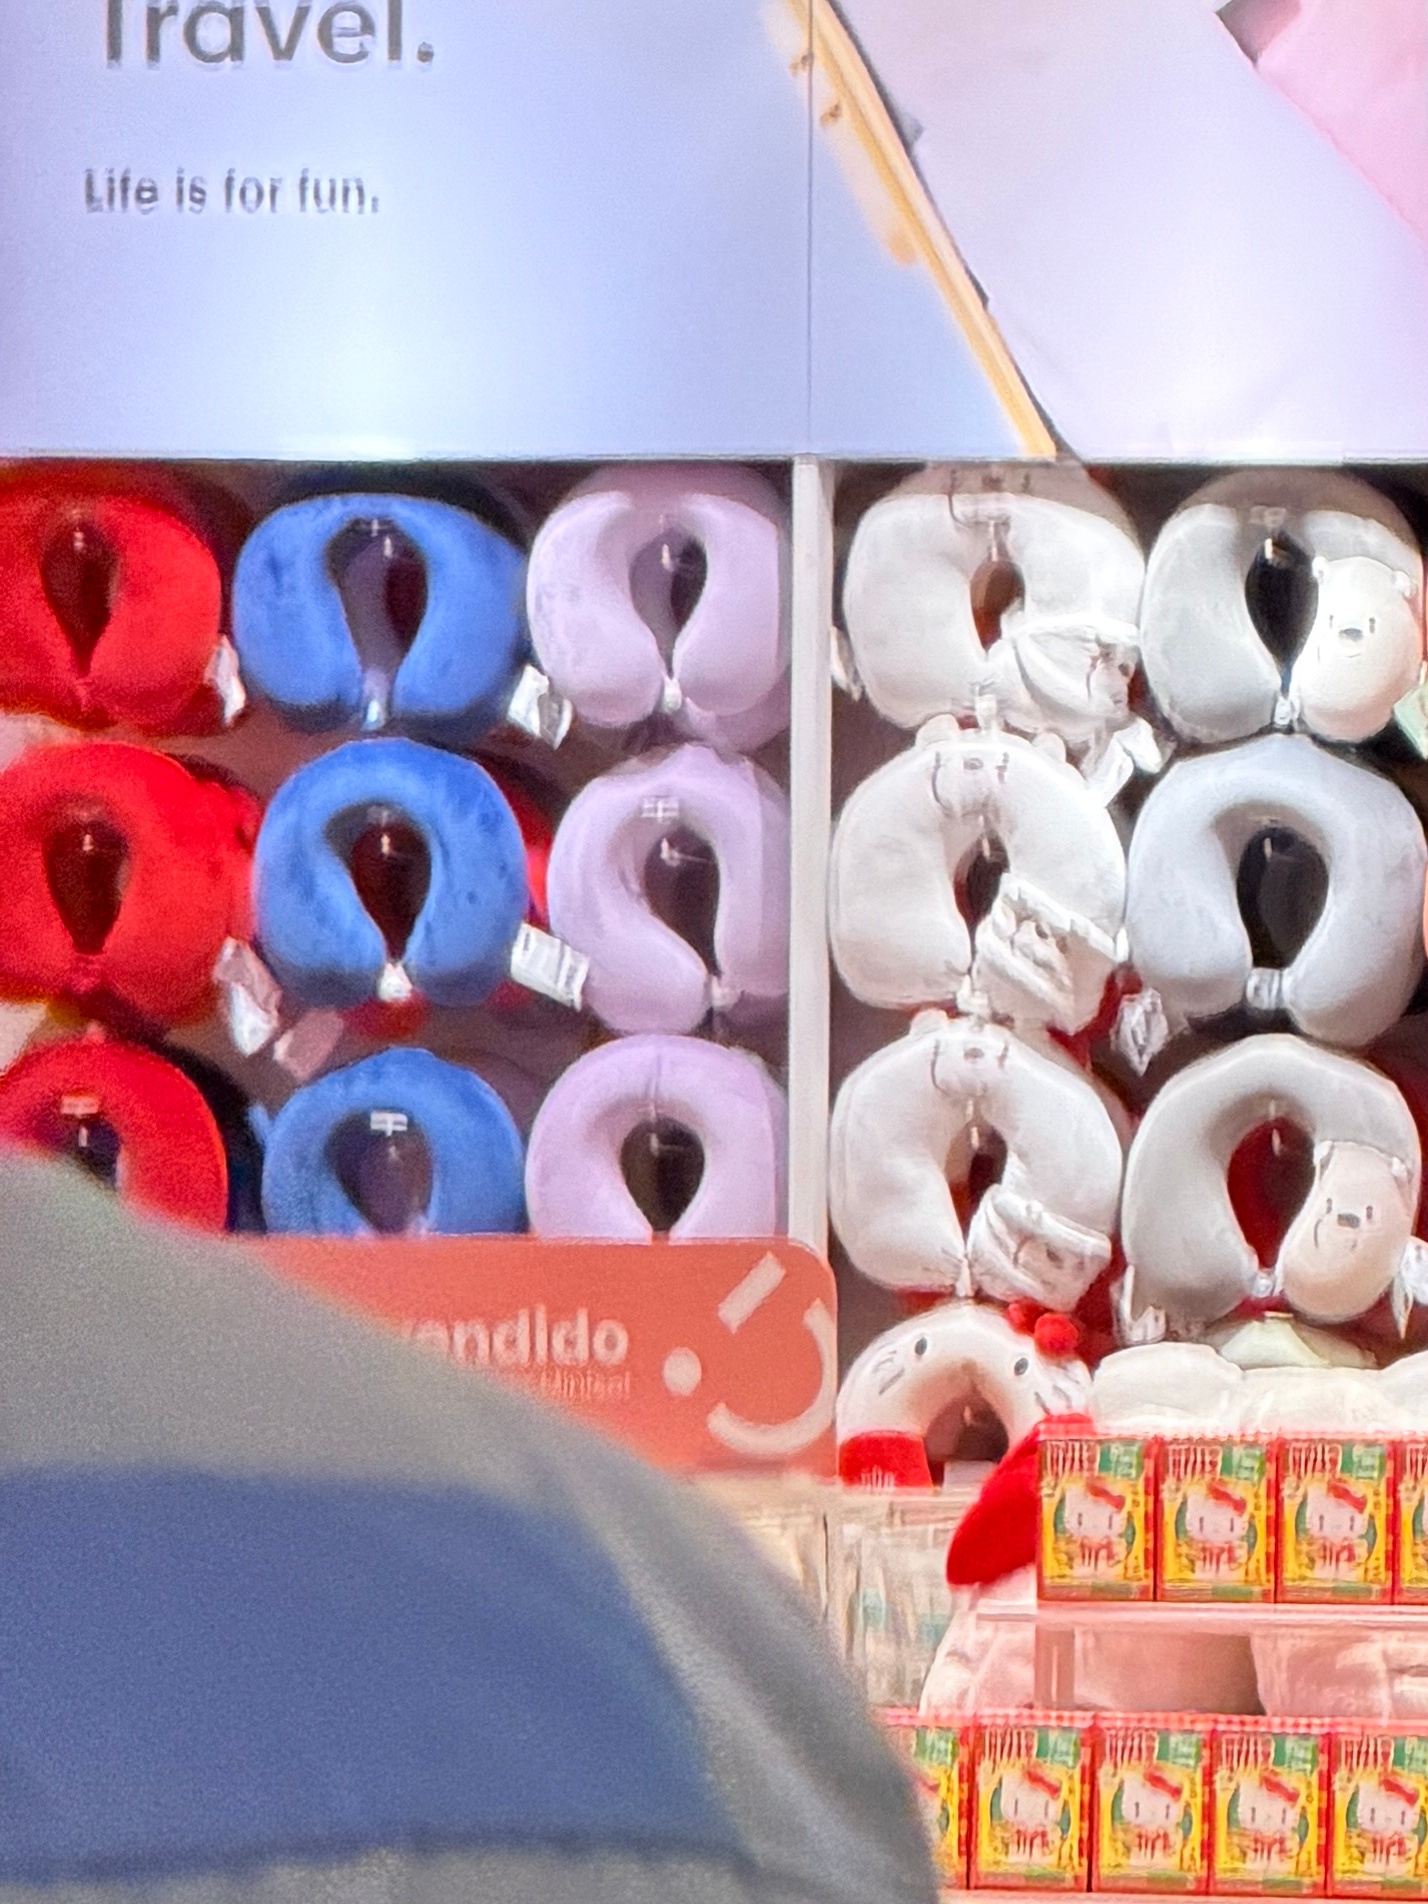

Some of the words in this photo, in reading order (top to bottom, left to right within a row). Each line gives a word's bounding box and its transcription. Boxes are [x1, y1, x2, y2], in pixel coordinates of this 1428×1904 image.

[84, 167, 159, 214] Life
[175, 167, 208, 214] is
[224, 167, 283, 214] for
[298, 167, 381, 214] fun.
